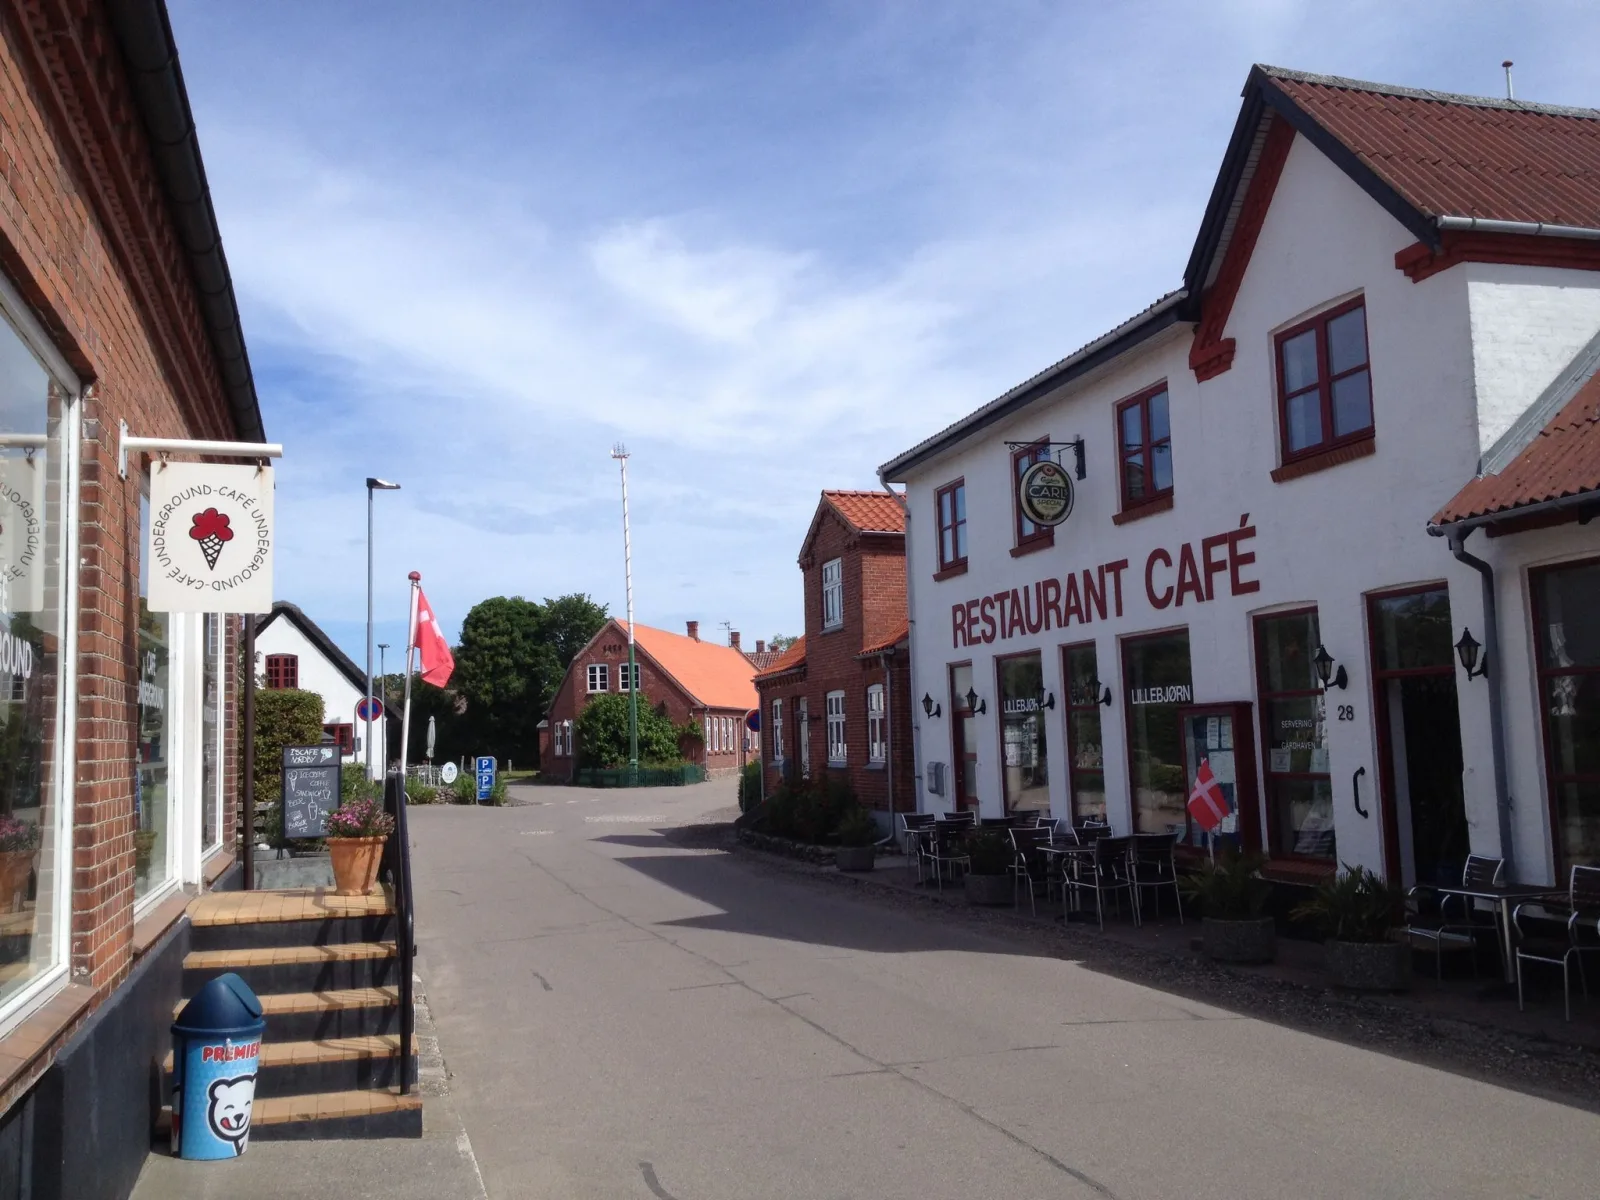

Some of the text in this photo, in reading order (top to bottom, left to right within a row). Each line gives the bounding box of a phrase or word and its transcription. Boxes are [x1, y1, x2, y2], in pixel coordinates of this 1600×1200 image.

[952, 513, 1260, 649] RESTAURANT CAFÉ
[1131, 685, 1191, 705] LILLEBJØRN
[1337, 705, 1354, 721] 28
[1281, 719, 1313, 728] SERVERING
[482, 759, 489, 769] P
[482, 776, 489, 786] P
